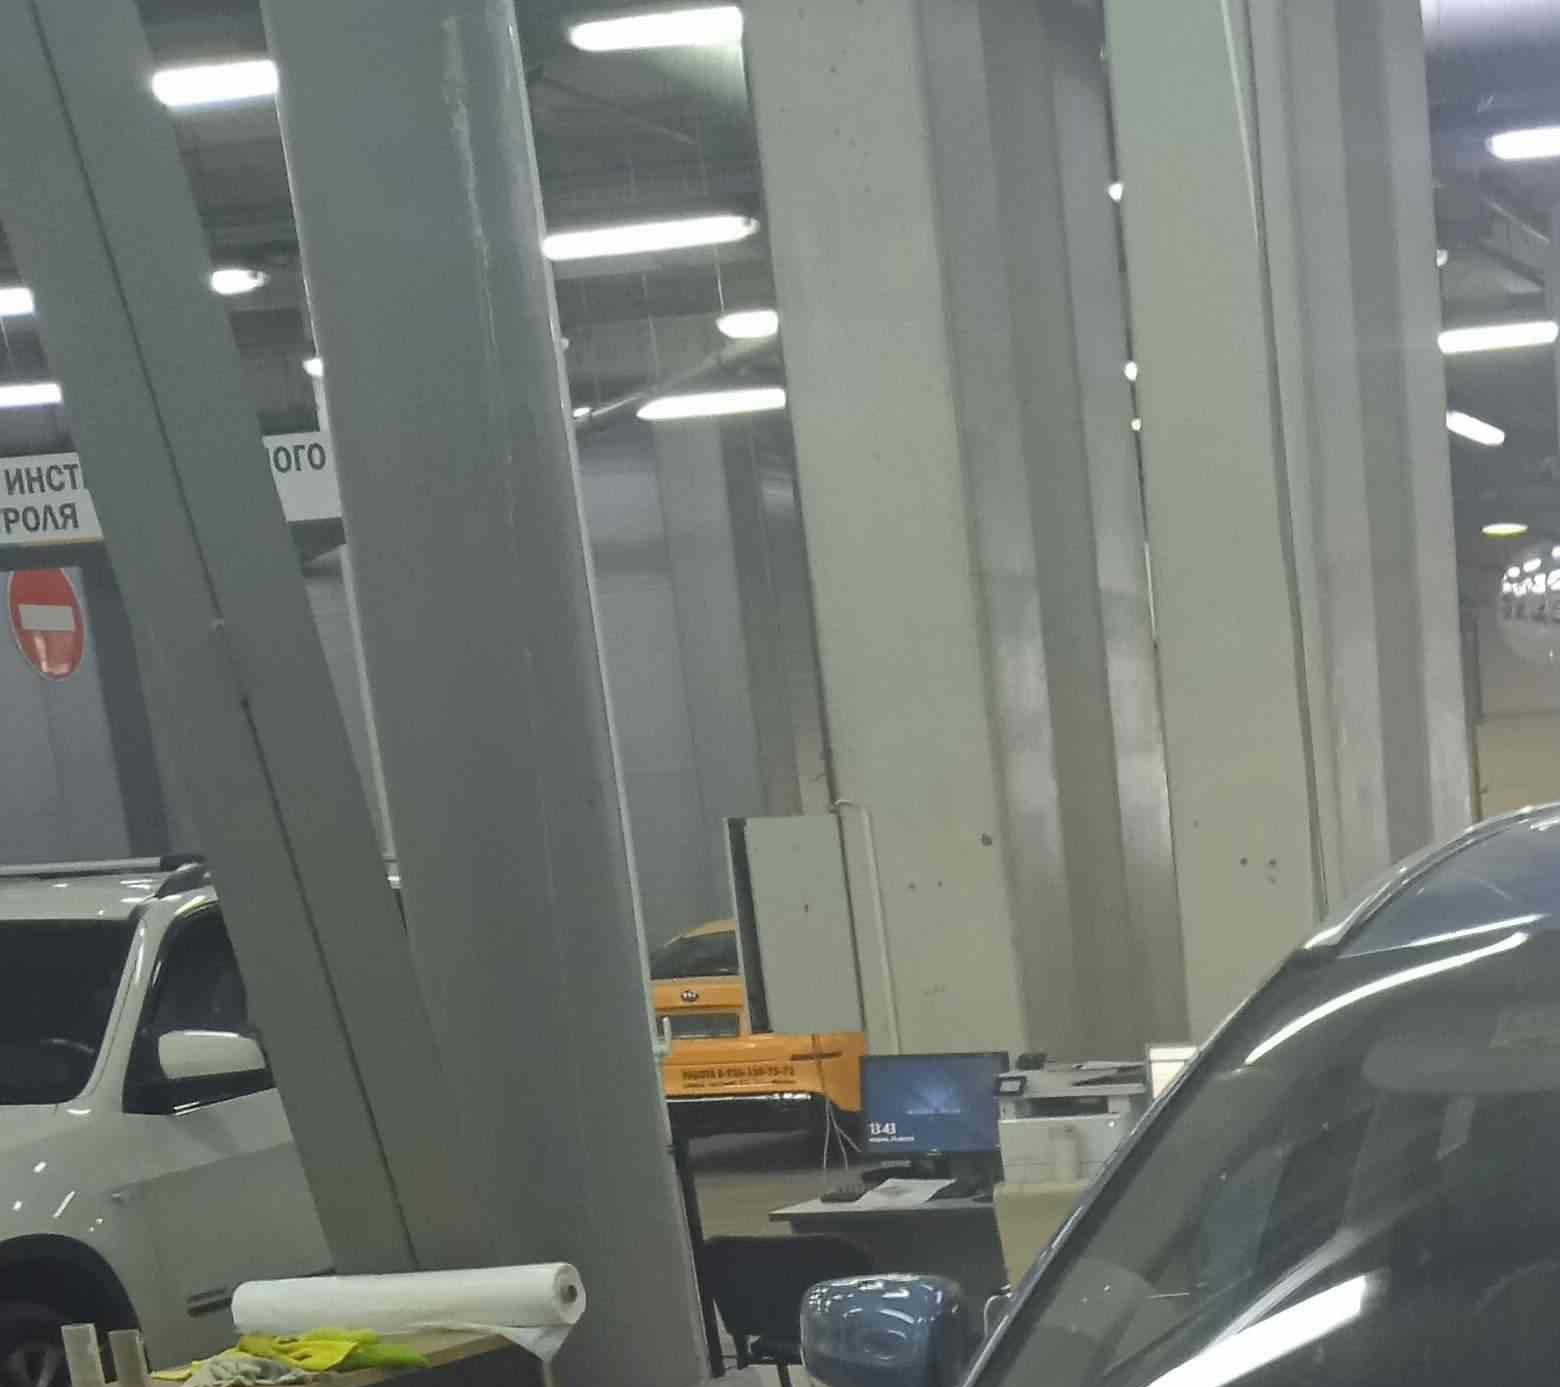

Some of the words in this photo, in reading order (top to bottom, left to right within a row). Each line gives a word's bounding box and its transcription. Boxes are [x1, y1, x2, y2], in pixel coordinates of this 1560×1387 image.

[4, 464, 82, 496] ИНСТ
[268, 442, 326, 473] ОГО
[0, 502, 80, 534] РОЛЯ
